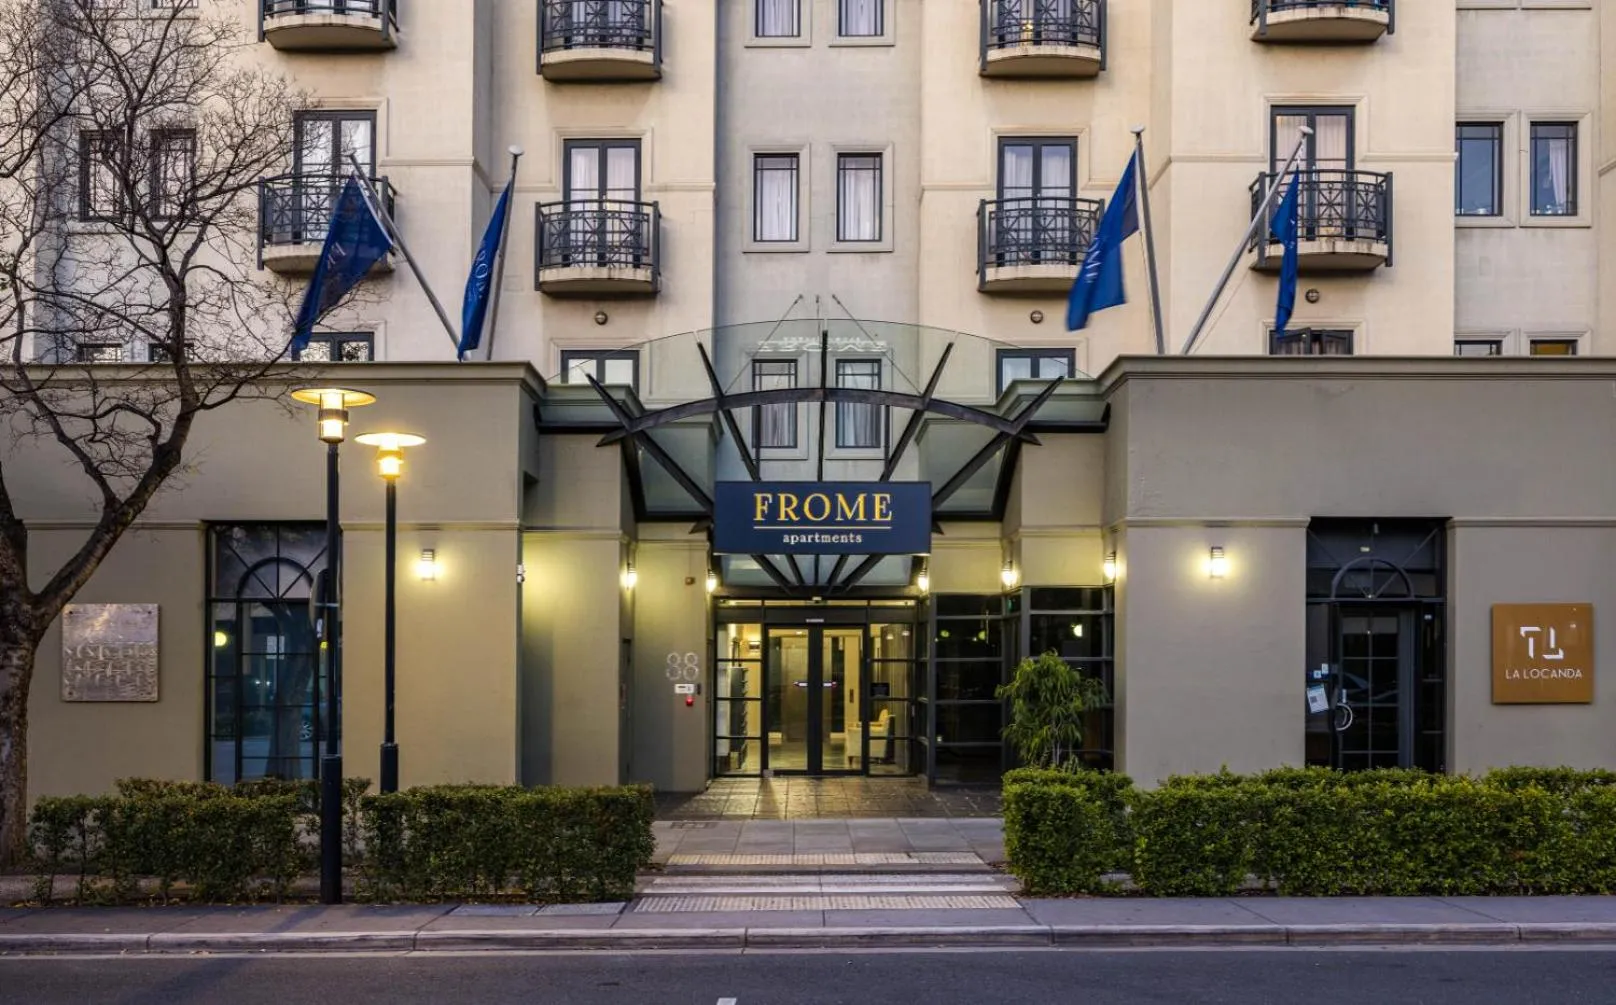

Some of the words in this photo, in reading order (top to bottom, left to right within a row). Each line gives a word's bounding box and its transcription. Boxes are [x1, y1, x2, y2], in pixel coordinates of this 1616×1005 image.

[753, 493, 893, 521] FROME
[783, 532, 863, 545] apartments
[665, 652, 699, 681] 88
[1505, 669, 1520, 680] LA
[1523, 668, 1583, 680] LOCANDA
